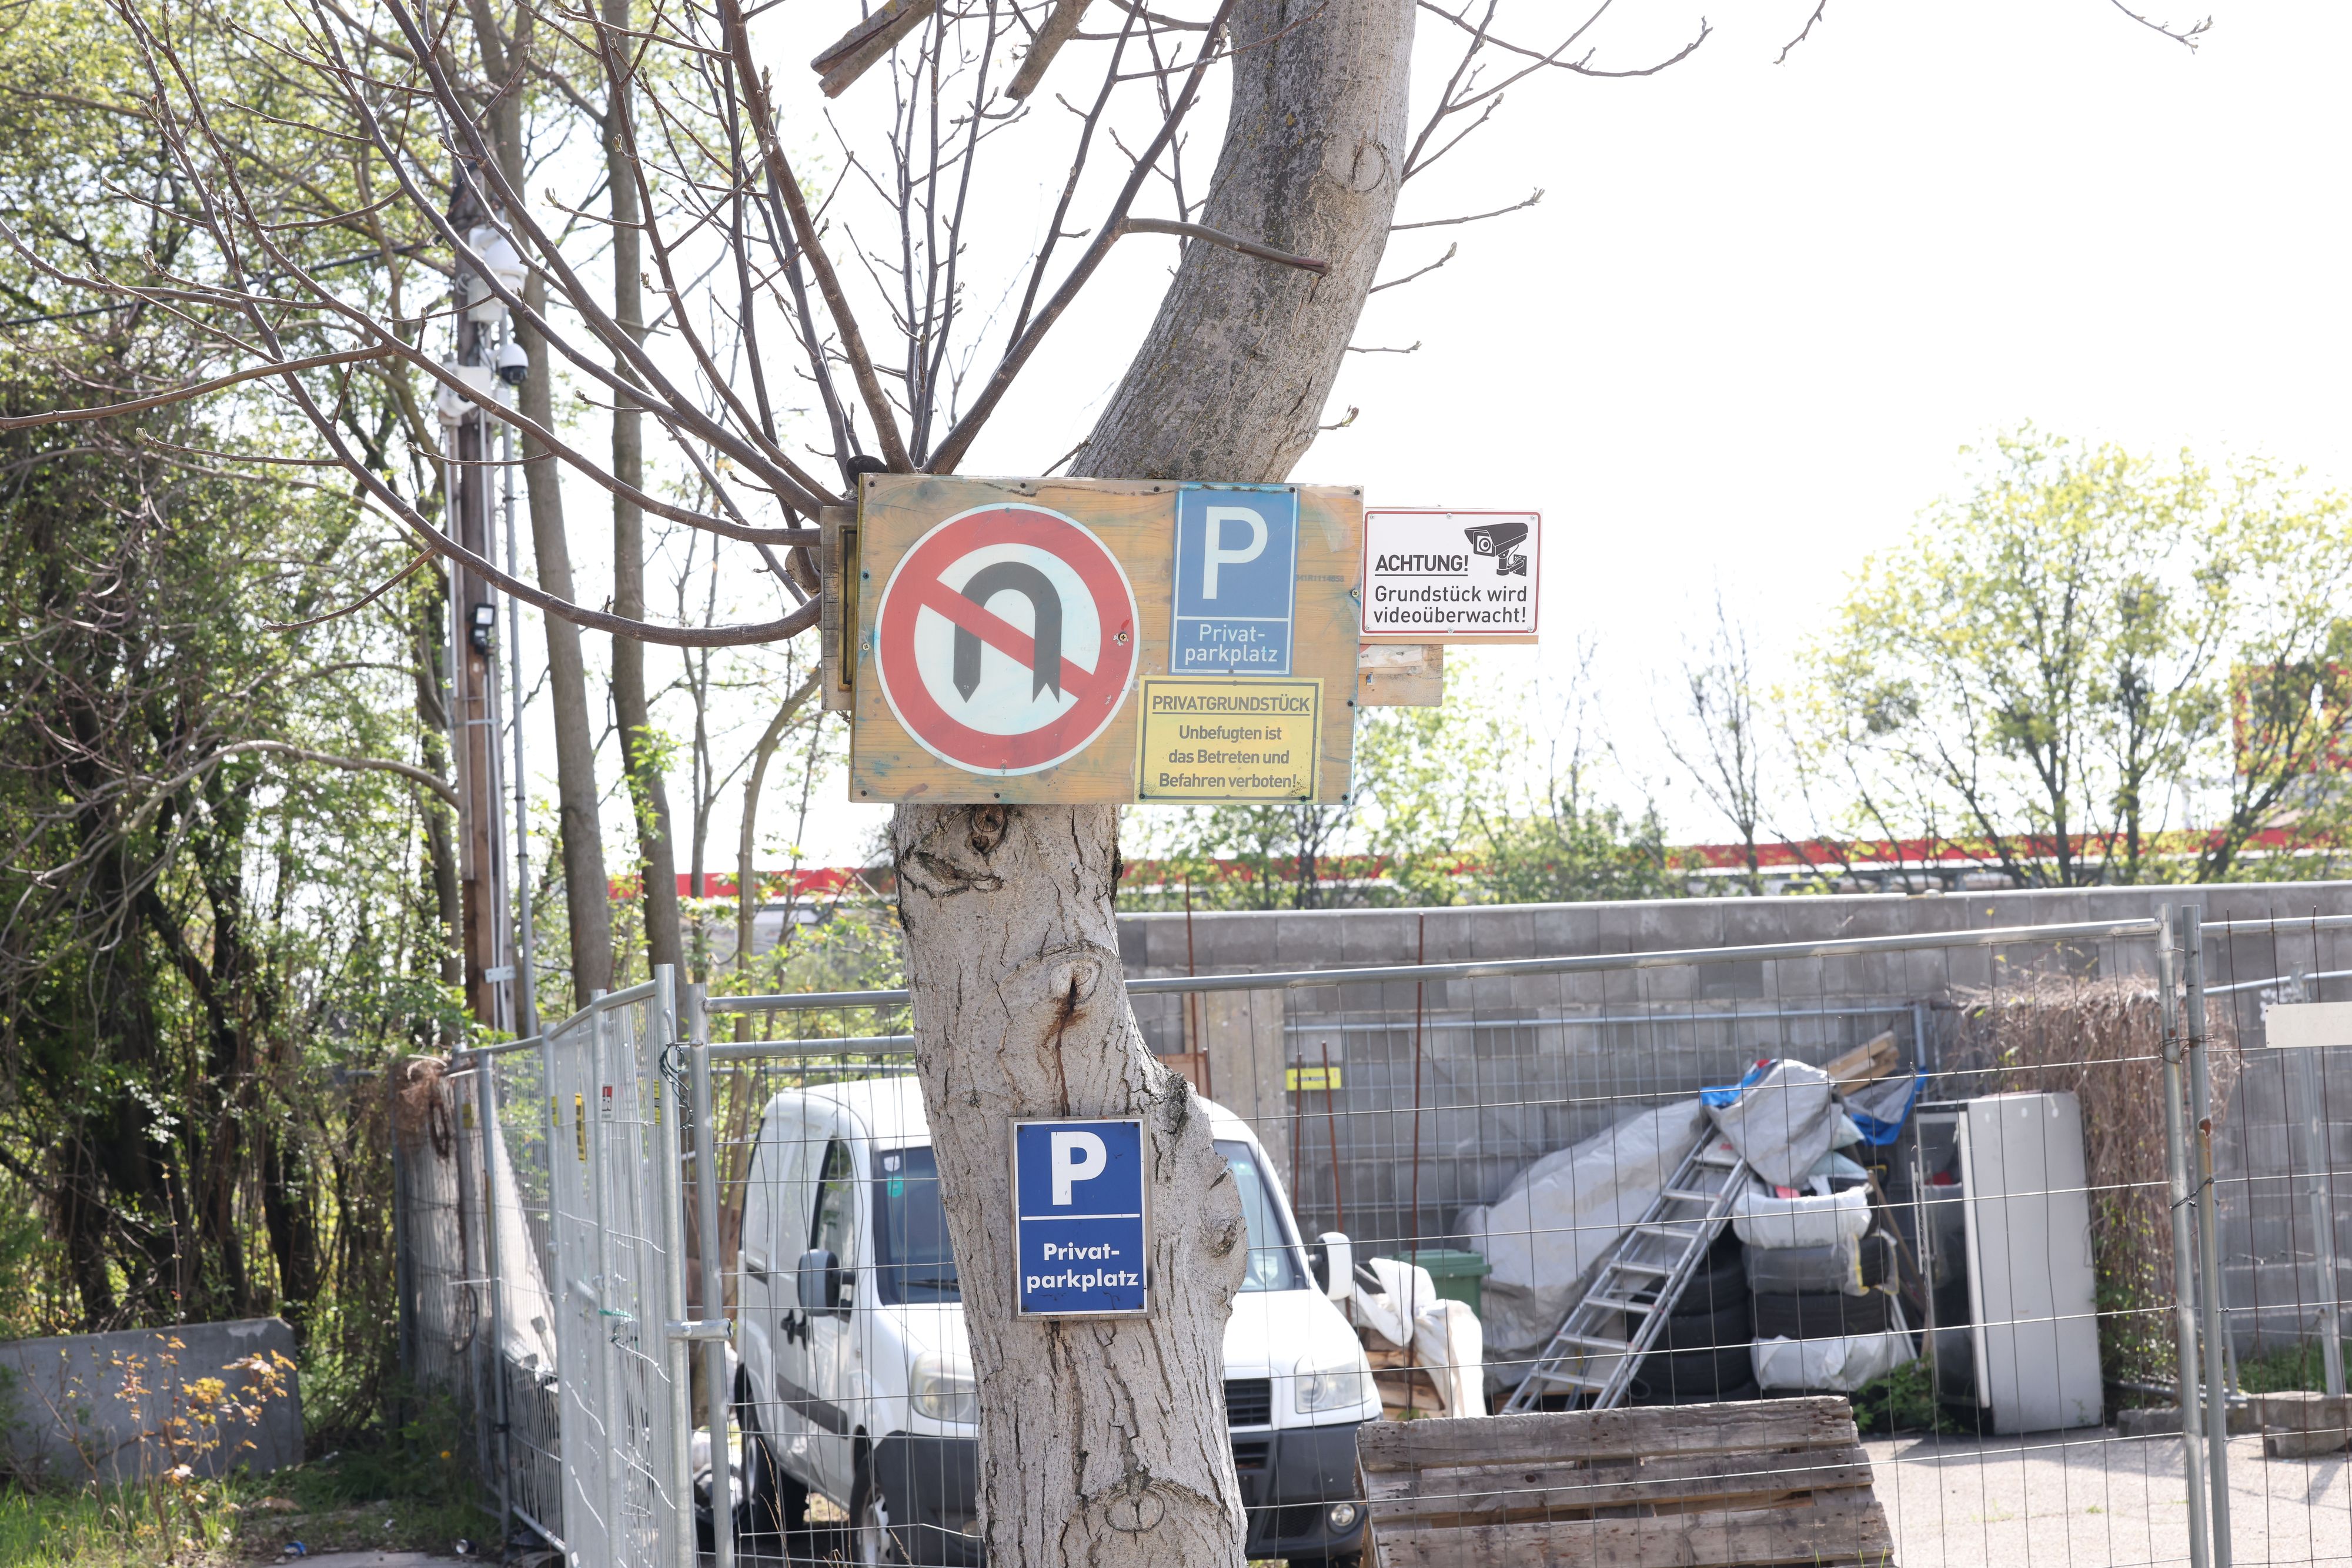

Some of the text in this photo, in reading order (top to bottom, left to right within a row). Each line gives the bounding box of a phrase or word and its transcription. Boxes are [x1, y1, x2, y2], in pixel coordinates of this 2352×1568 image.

[1202, 506, 1268, 600] P
[1375, 554, 1468, 571] ACHTUNG!
[1375, 585, 1527, 602] Grundstück wird
[1374, 606, 1526, 623] videoüberwacht!
[1200, 624, 1265, 642] Privat-
[1185, 644, 1278, 666] parkplatz
[1152, 693, 1310, 712] PRIVATGRUNDSTÜCK
[1179, 725, 1282, 743] Unbefugten ist
[1168, 748, 1289, 764] das Betreten und
[1159, 773, 1297, 788] Befahren verboten!
[1051, 1131, 1107, 1205] P
[1044, 1242, 1120, 1261] Privat-
[1027, 1268, 1138, 1293] parkplatz
